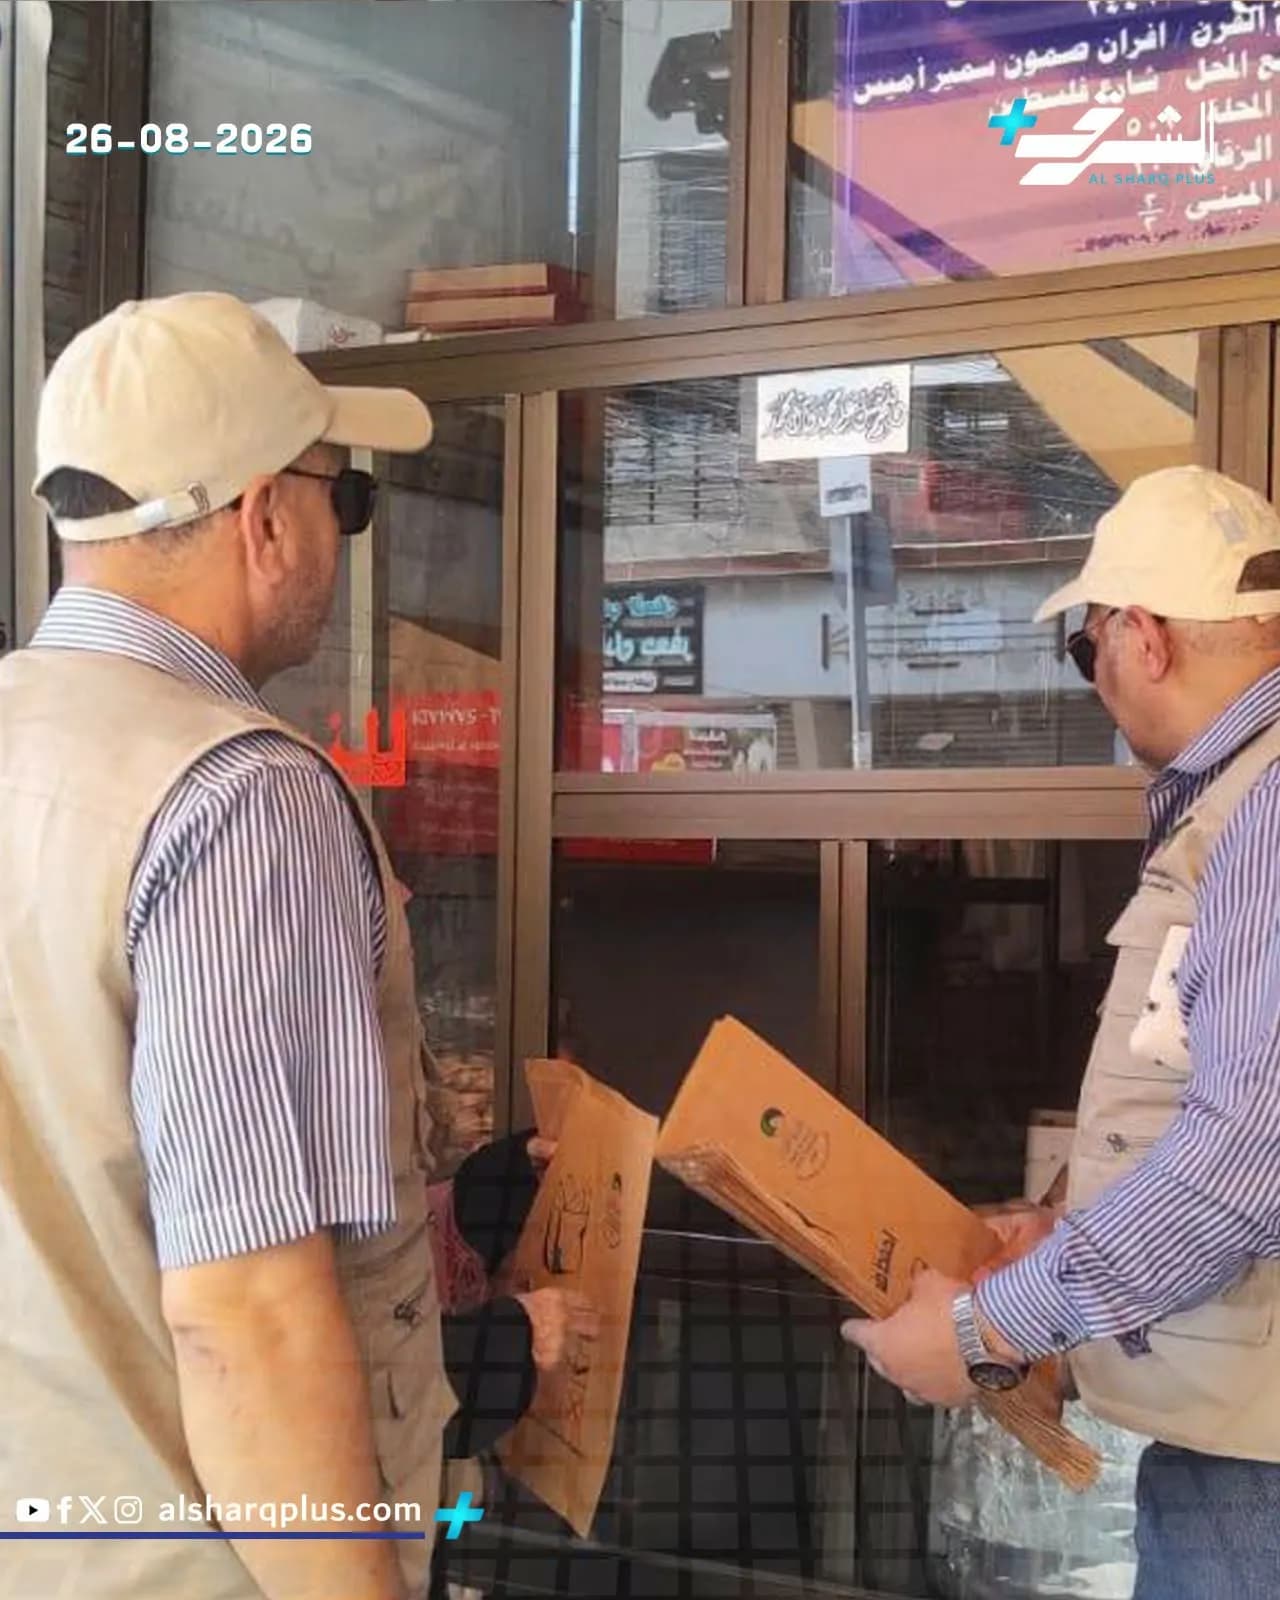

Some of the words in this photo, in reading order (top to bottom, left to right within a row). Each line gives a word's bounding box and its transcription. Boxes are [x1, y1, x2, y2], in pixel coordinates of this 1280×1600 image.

[1003, 41, 1090, 79] صمون
[1097, 20, 1166, 63] افران
[928, 58, 996, 93] سمير
[988, 76, 1089, 120] فلسطن
